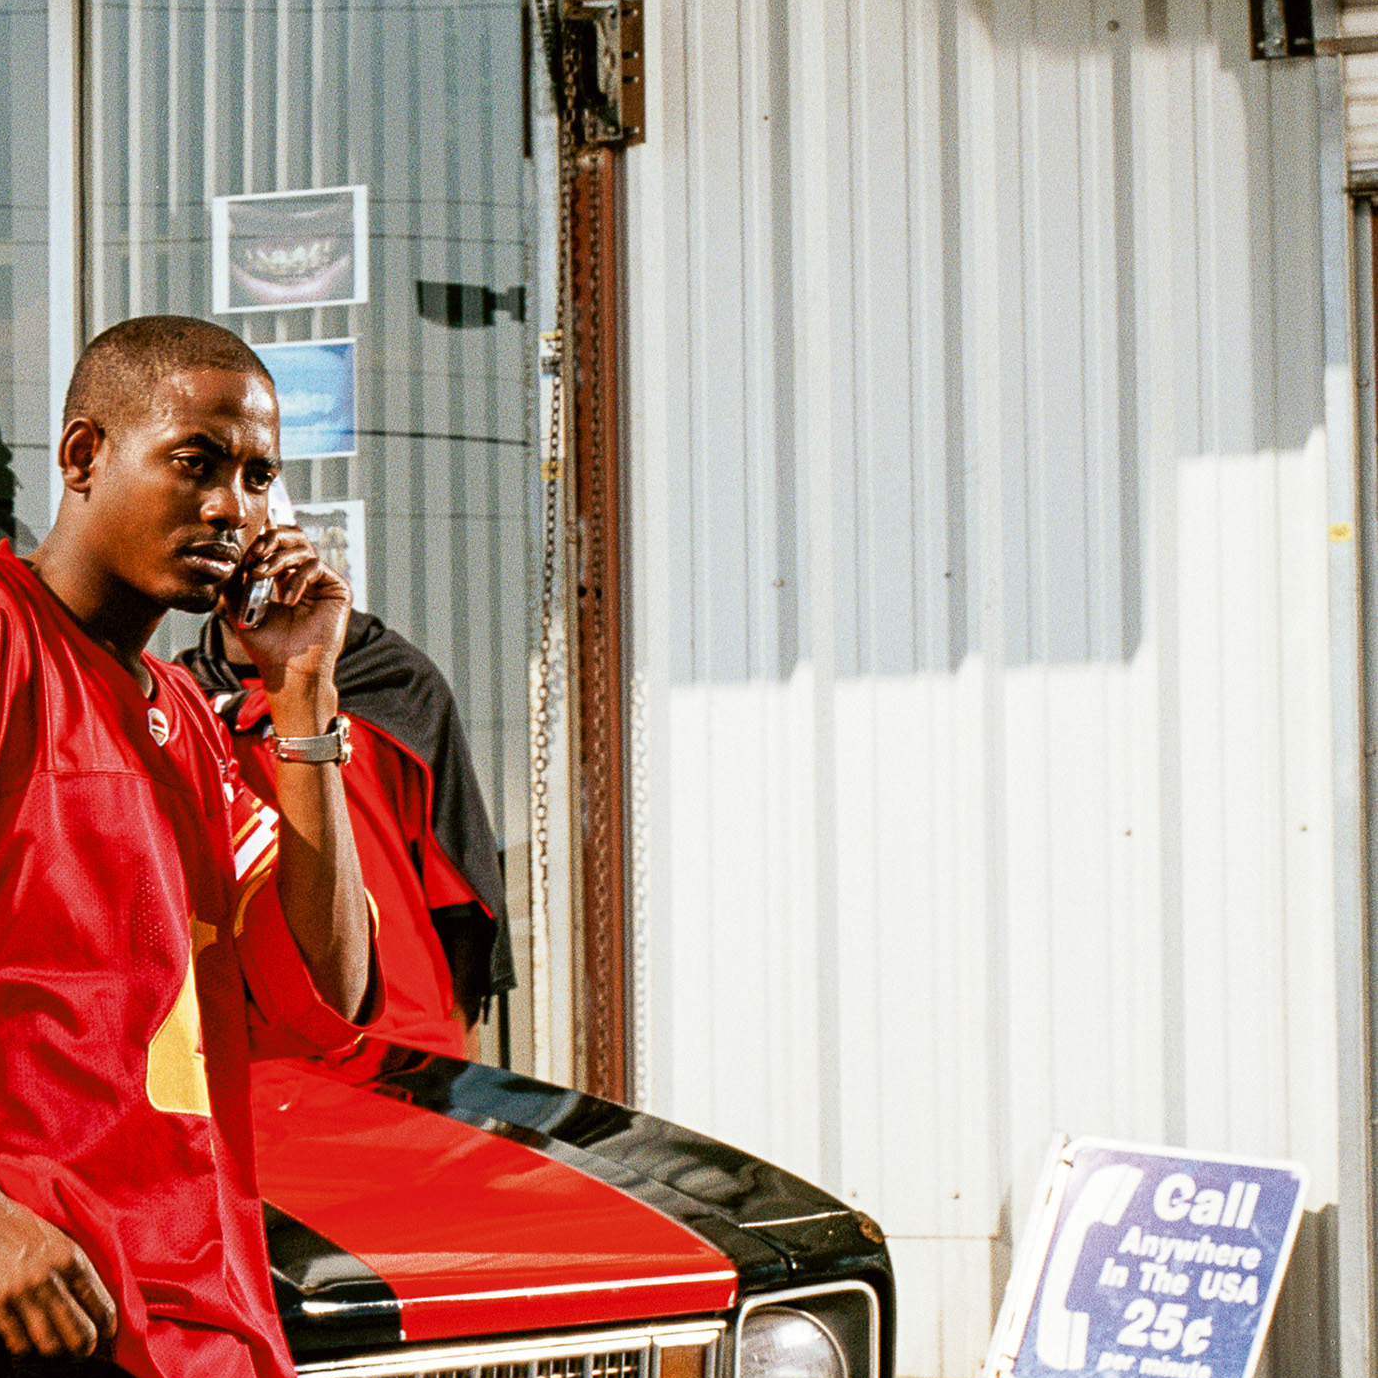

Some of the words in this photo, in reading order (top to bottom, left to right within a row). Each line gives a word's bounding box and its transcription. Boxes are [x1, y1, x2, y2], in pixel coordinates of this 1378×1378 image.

[1152, 1172, 1261, 1230] Call
[1118, 1225, 1262, 1271] Anywhere
[1098, 1257, 1130, 1288] In
[1138, 1261, 1190, 1296] The
[1198, 1269, 1259, 1305] USA
[1116, 1297, 1213, 1357] 25¢
[1097, 1351, 1136, 1372] per
